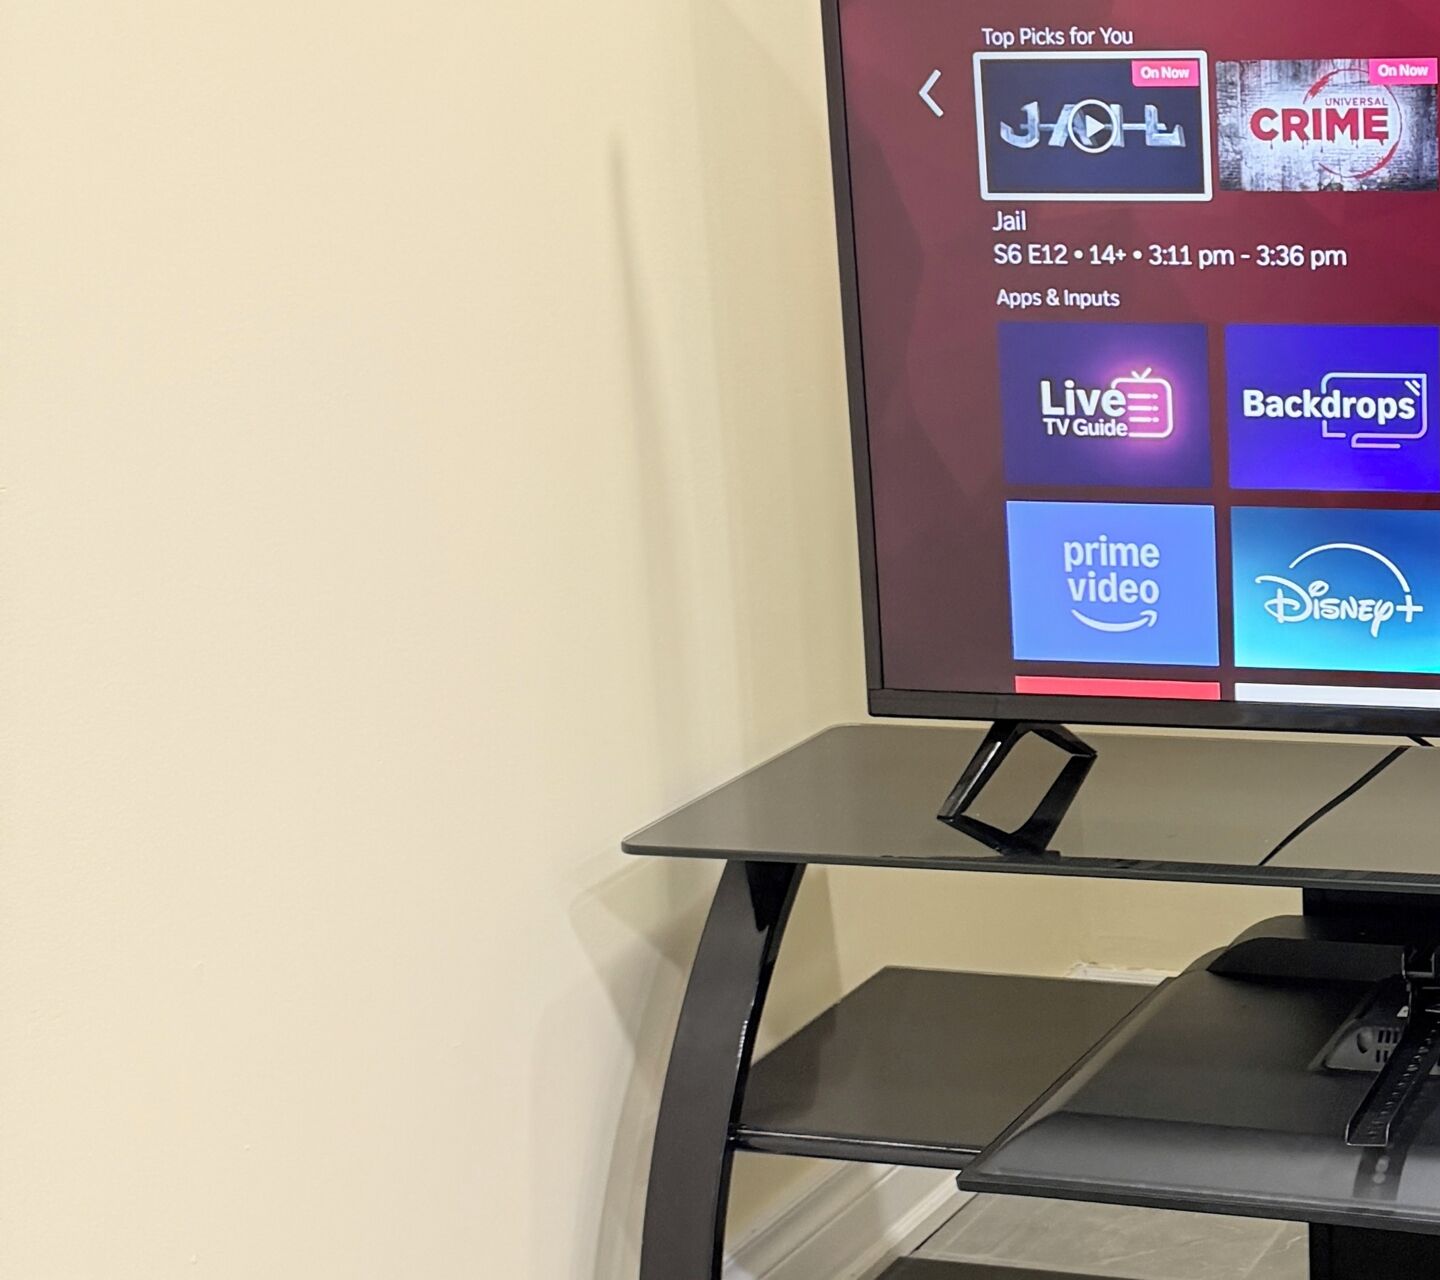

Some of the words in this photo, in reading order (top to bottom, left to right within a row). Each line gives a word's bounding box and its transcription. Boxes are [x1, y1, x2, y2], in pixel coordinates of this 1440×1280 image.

[981, 27, 1015, 49] Top
[1019, 27, 1065, 46] Picks
[1069, 26, 1096, 45] for
[1099, 26, 1134, 45] You
[1140, 66, 1158, 80] On
[1161, 65, 1190, 80] Now
[1377, 63, 1396, 78] On
[1399, 63, 1428, 78] Now
[1325, 97, 1388, 107] UNIVERSAL
[1249, 107, 1390, 144] CRIME
[992, 210, 1027, 232] Jail
[994, 244, 1022, 264] S6
[1028, 245, 1068, 265] E12
[1089, 245, 1127, 266] 14+
[1148, 245, 1192, 266] 3:11
[1199, 250, 1234, 269] pm
[1256, 245, 1304, 267] 3:36
[1310, 250, 1347, 270] pm
[997, 289, 1042, 309] Apps
[1046, 289, 1060, 306] &
[1064, 289, 1120, 309] Inputs
[1040, 380, 1126, 417] Live
[1242, 389, 1416, 425] Backdrops
[1043, 418, 1069, 435] TV
[1072, 418, 1128, 438] Guide
[1064, 534, 1160, 572] prime
[1067, 571, 1160, 605] video
